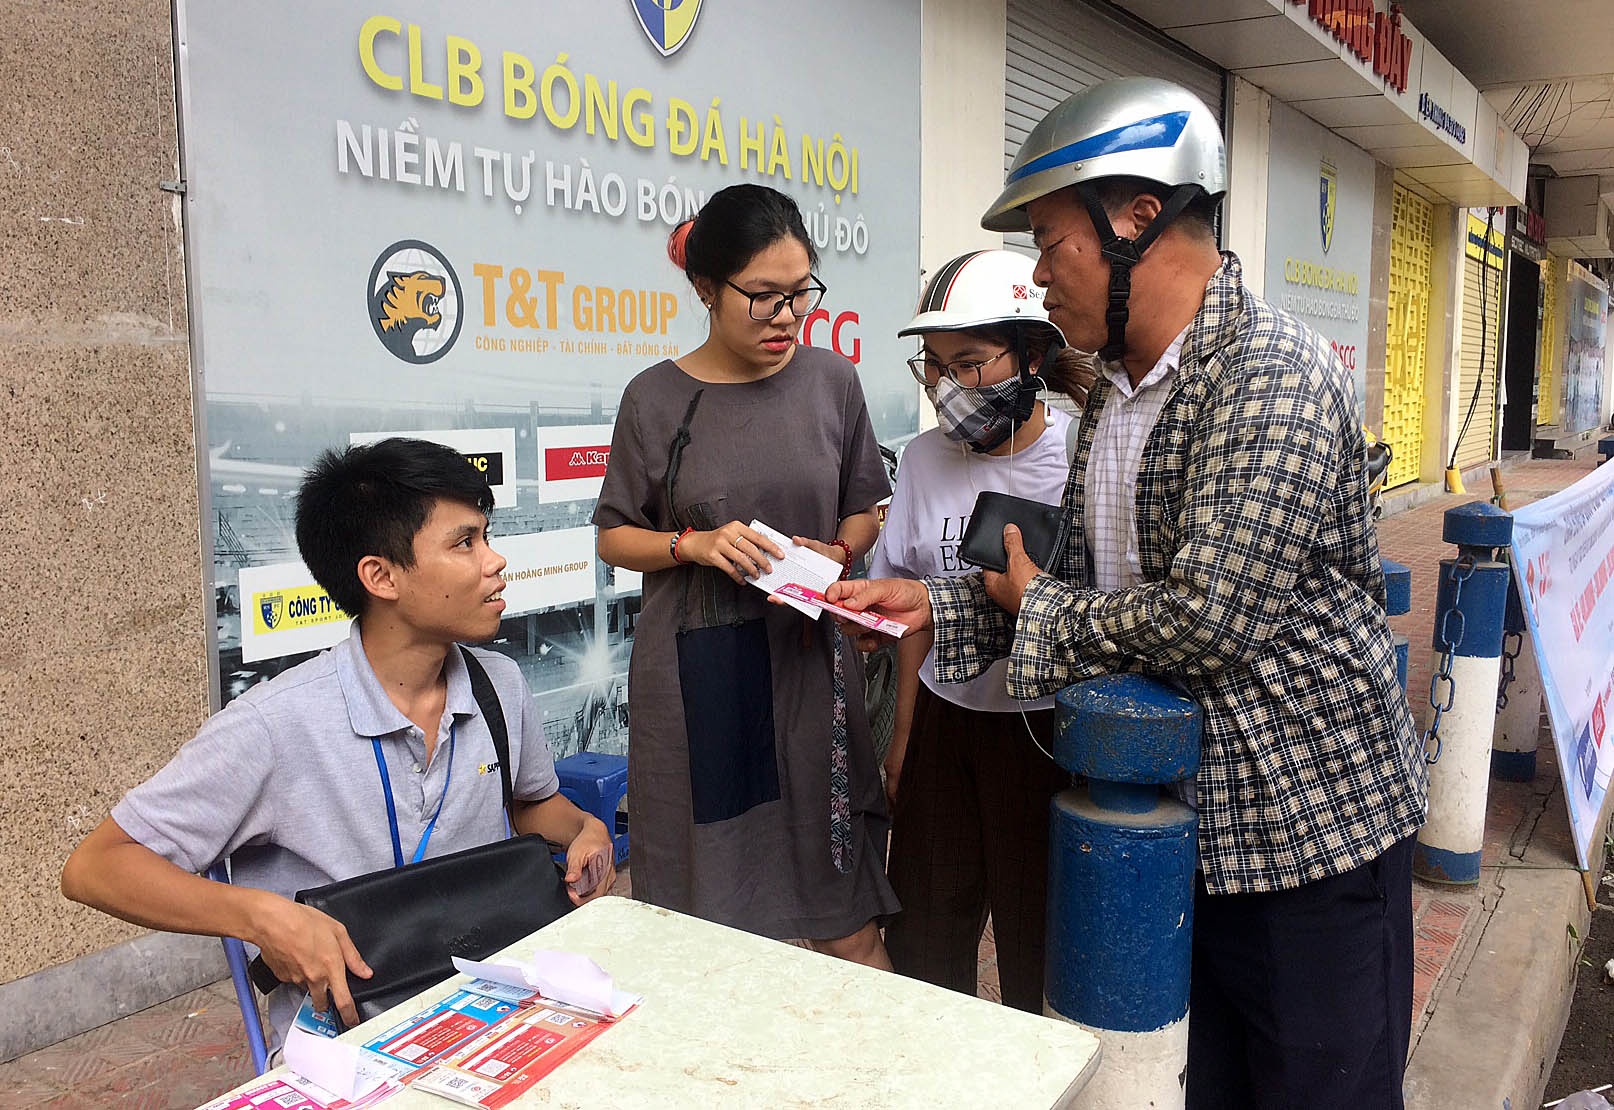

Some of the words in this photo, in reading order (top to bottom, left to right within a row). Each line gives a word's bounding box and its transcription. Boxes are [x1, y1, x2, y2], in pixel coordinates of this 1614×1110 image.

[359, 15, 485, 106] CLB
[503, 51, 655, 147] BÓNG
[666, 96, 728, 165] ĐÁ
[740, 114, 792, 179] HÀ
[802, 132, 858, 205] NỘI
[336, 116, 465, 192] NIỀM
[474, 147, 535, 215] TỰ
[546, 157, 627, 216] HÀO
[835, 213, 869, 254] ĐÔ
[473, 263, 565, 330] T&T
[572, 285, 678, 335] GROUP
[475, 335, 506, 351] CÔNG
[560, 339, 574, 354] TÀI
[578, 338, 607, 355] CHÍNH
[796, 309, 861, 364] CG
[941, 515, 973, 541] LI
[500, 571, 513, 582] ÂN
[515, 568, 542, 581] HOÀNG
[544, 564, 563, 576] MINH
[564, 561, 588, 573] GROUP
[289, 595, 317, 618] CÔNG
[319, 595, 331, 613] TY
